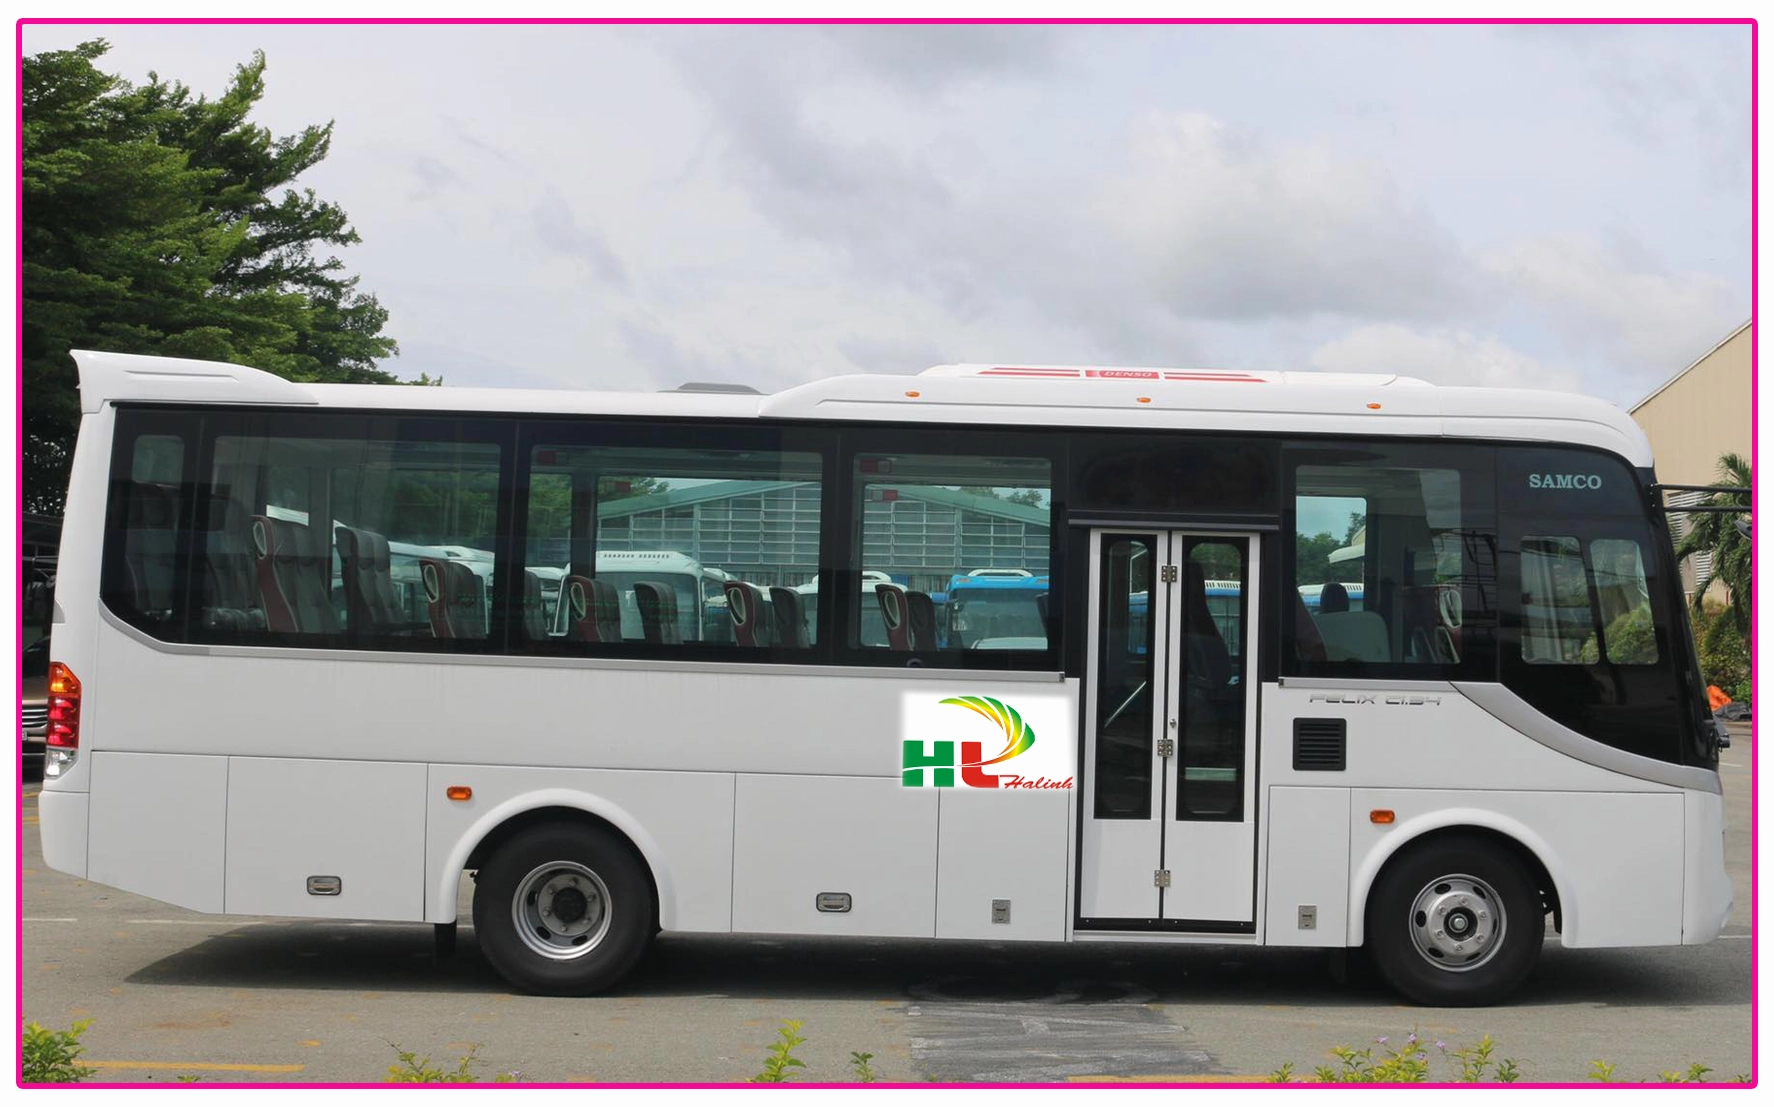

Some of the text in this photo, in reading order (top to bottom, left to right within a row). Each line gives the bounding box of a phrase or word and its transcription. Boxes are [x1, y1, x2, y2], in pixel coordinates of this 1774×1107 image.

[1103, 370, 1152, 378] DENSO
[1529, 473, 1602, 490] SAMCO
[1309, 693, 1376, 705] FELIX
